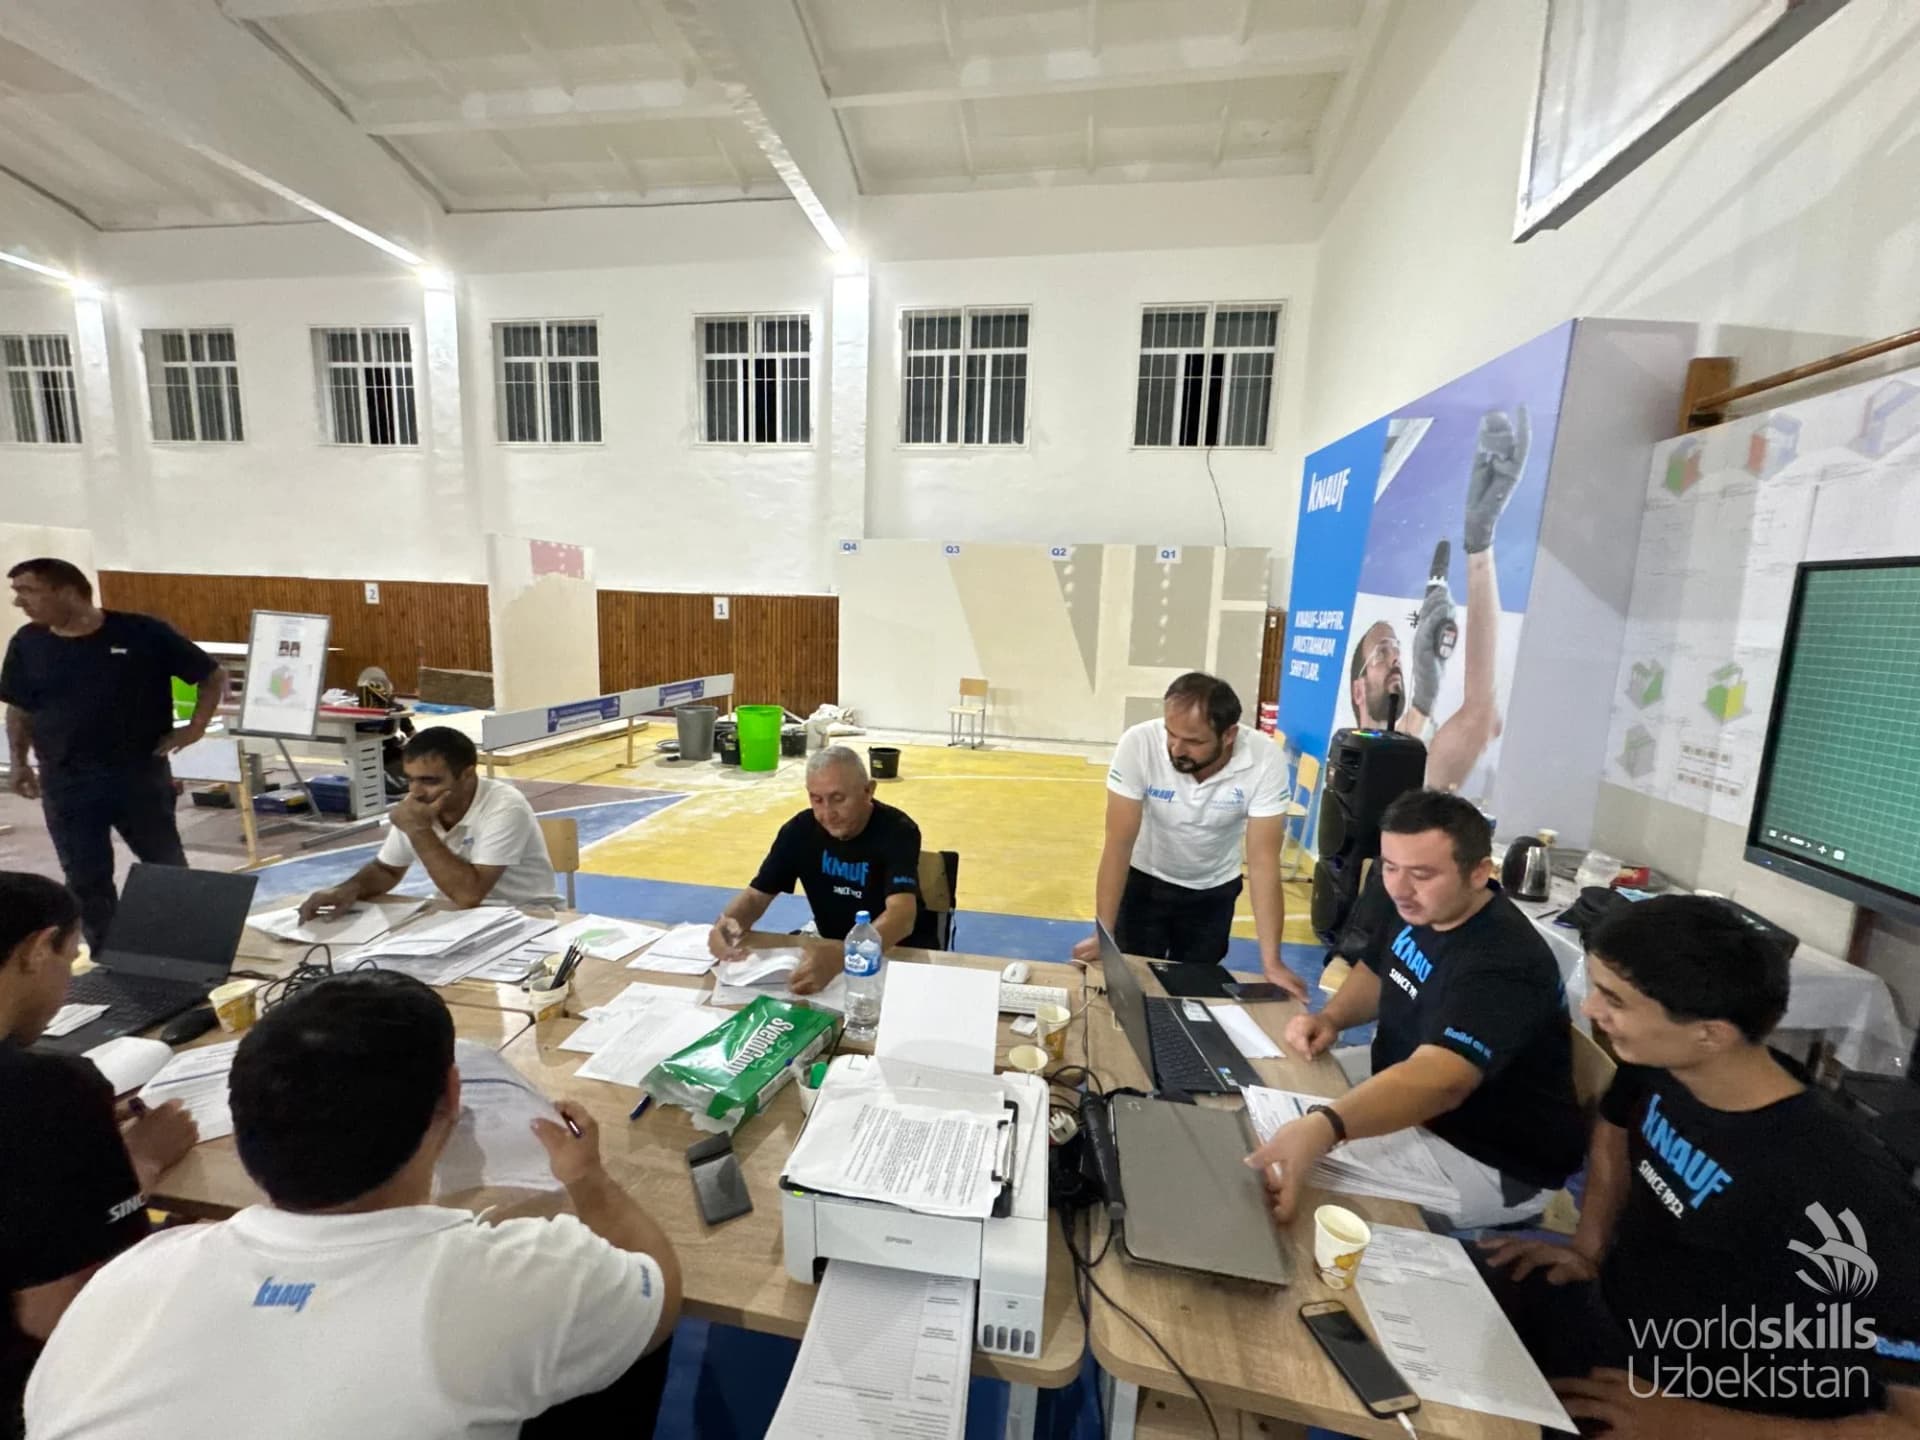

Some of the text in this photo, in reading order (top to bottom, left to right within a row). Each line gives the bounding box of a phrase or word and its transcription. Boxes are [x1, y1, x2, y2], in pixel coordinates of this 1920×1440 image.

[1307, 466, 1352, 513] KNAUF
[842, 542, 857, 551] Q4
[945, 545, 960, 554] Q3
[1051, 547, 1067, 557] Q2
[1160, 549, 1176, 559] Q1
[368, 588, 377, 600] 2
[717, 603, 726, 616] 1
[1391, 924, 1434, 984] KNAU
[1641, 1093, 1734, 1211] KNAUF
[1638, 1159, 1668, 1196] SINCE
[105, 1192, 147, 1224] SINC
[253, 1276, 316, 1313] KNAUF
